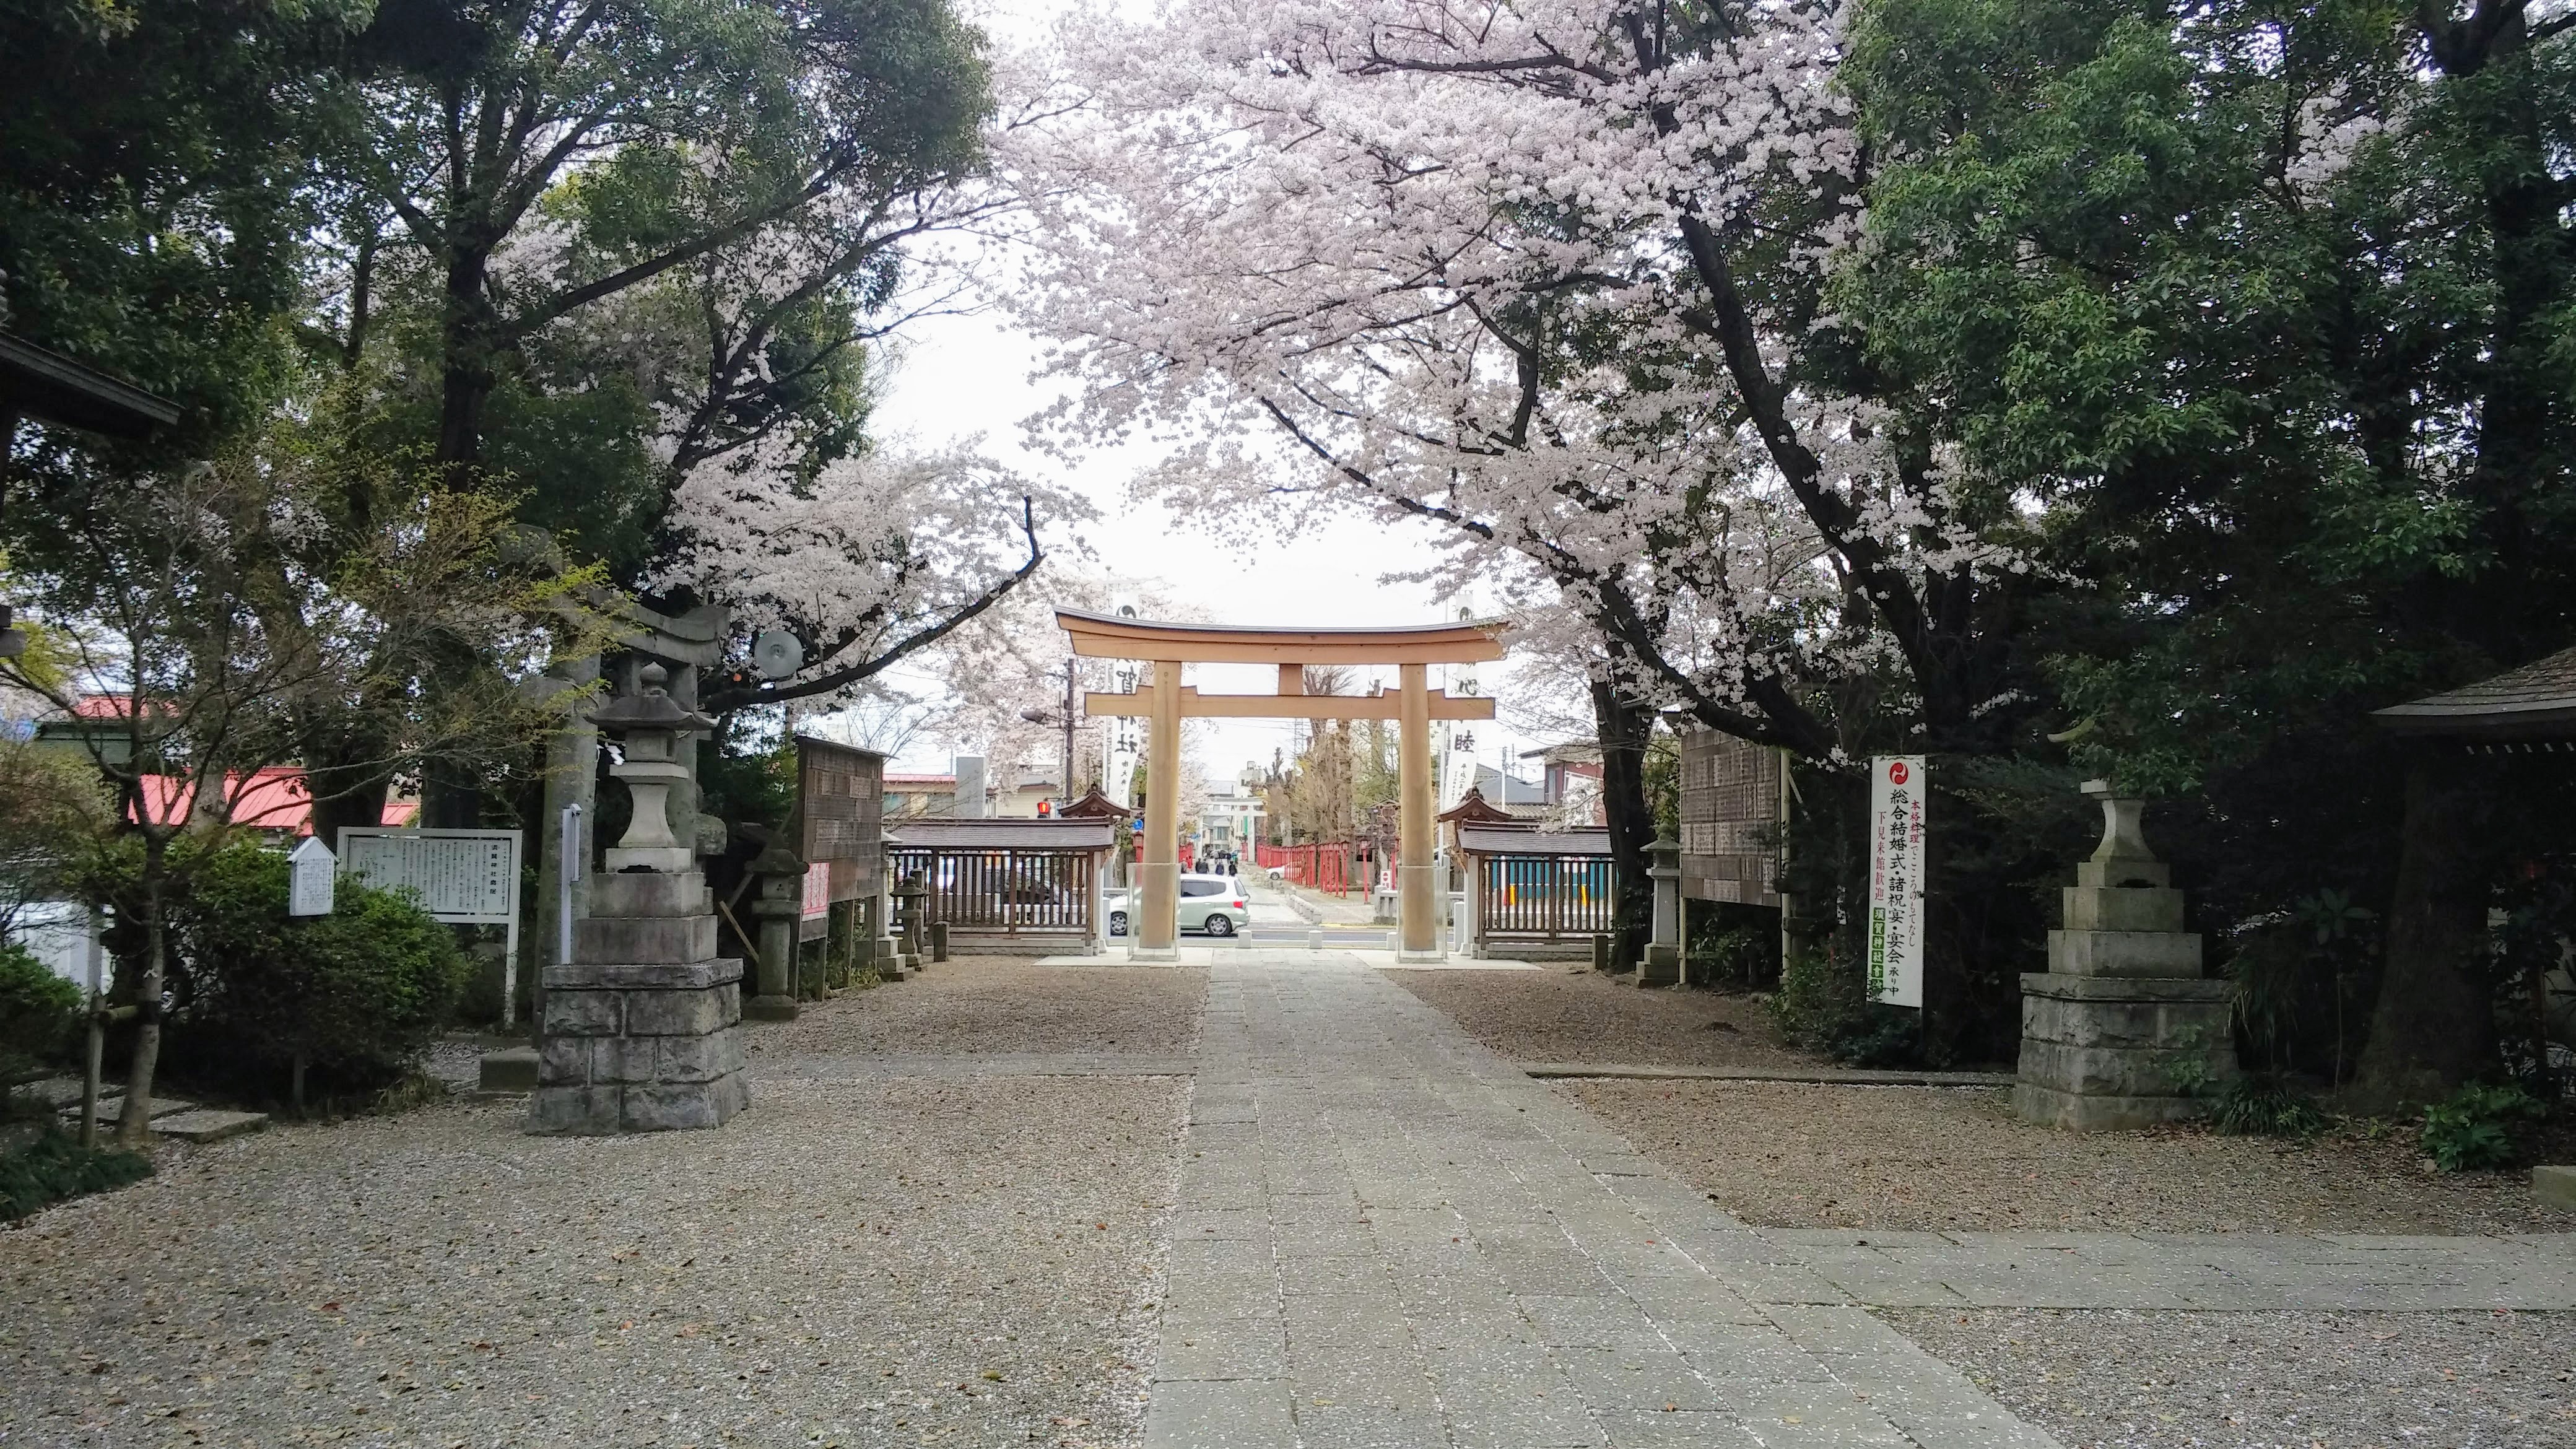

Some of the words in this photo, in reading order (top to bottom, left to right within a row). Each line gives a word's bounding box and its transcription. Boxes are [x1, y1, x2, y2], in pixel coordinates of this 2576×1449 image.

[1874, 811, 1887, 901] 下見来館歓迎
